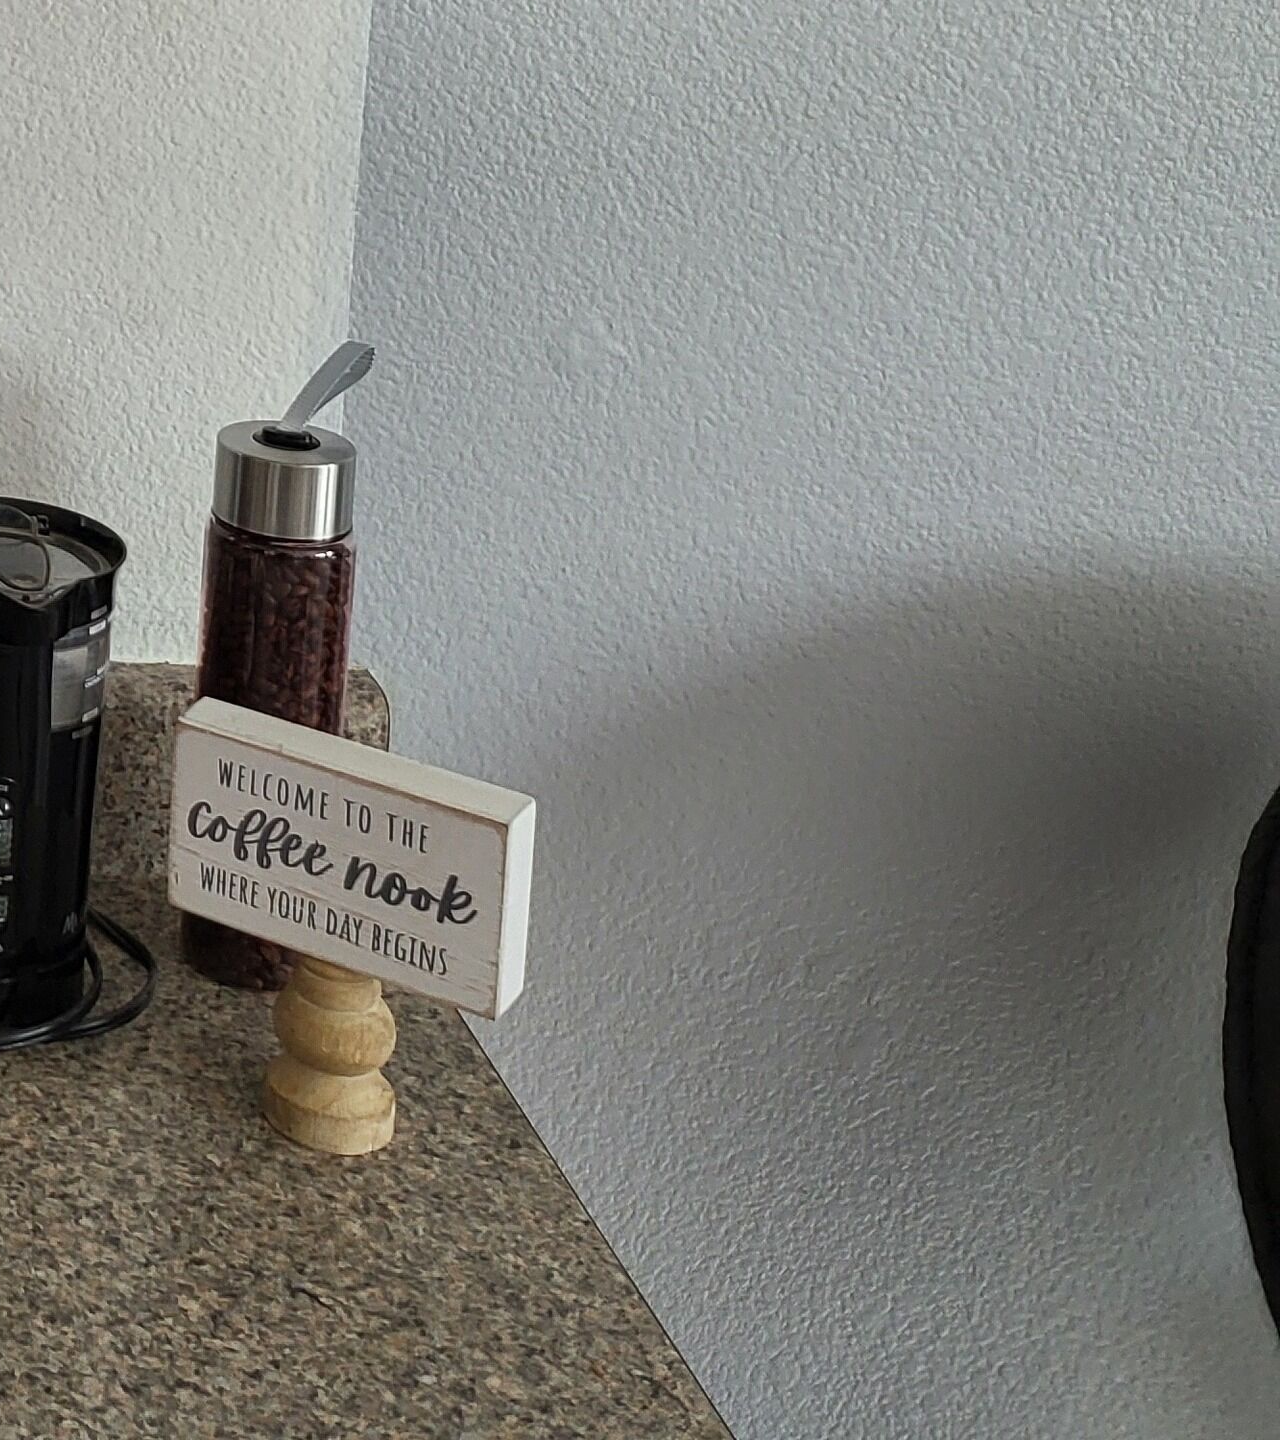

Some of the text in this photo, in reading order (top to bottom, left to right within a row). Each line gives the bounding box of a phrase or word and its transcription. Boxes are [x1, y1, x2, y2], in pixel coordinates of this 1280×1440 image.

[217, 757, 430, 855] WELCOME TO THE
[199, 862, 448, 976] WHERE YOUR DAY BEGINS
[343, 855, 478, 925] nook
